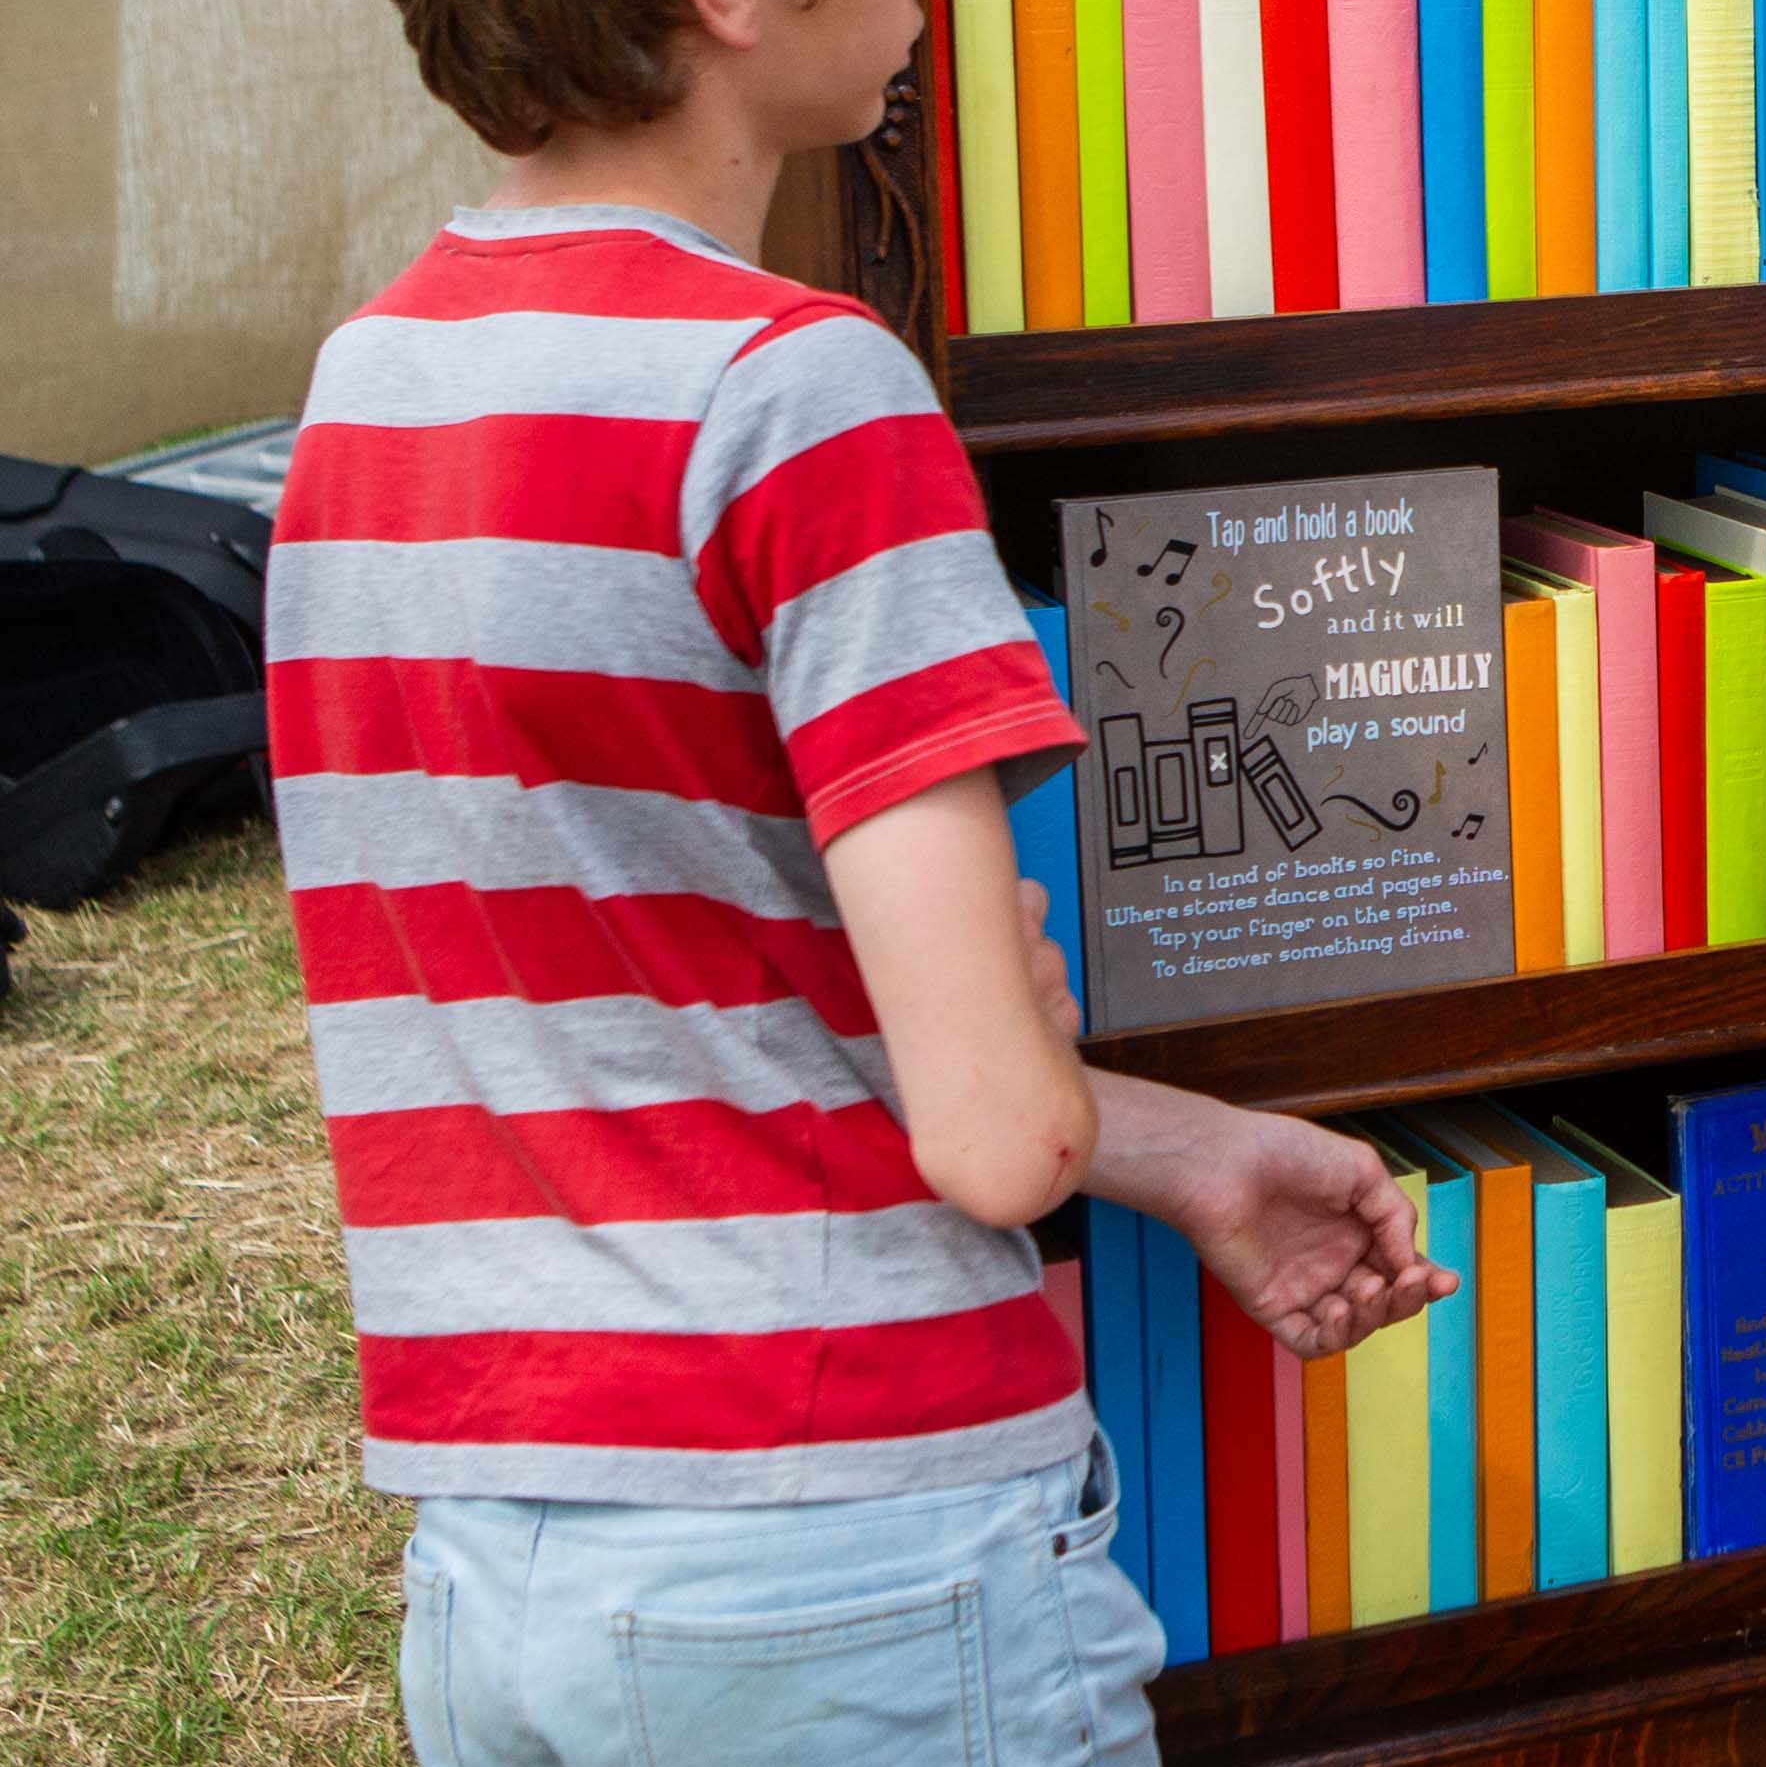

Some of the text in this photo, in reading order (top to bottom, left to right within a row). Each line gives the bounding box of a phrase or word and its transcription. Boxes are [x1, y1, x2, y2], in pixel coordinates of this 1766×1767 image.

[1205, 497, 1415, 556] Tap and hold a book
[1253, 546, 1406, 630] Softly
[1327, 603, 1465, 635] and it will
[1325, 651, 1492, 700] MAGICALLY
[1307, 708, 1466, 753] play a sound
[1163, 874, 1185, 893] In
[1187, 878, 1203, 892] a
[1207, 864, 1259, 890] land
[1265, 862, 1289, 882] of
[1294, 855, 1357, 878] books
[1362, 857, 1386, 870] so
[1105, 905, 1179, 927] Where
[1183, 893, 1258, 917] stories
[1263, 887, 1330, 907] dance
[1333, 877, 1375, 899] and
[1381, 874, 1443, 902] pages
[1148, 926, 1187, 951] Tap
[1191, 926, 1243, 950] your
[1249, 917, 1315, 940] finger
[1321, 914, 1349, 928] on
[1354, 905, 1391, 924] the
[1151, 959, 1177, 979] To
[1182, 952, 1273, 975] discover
[1279, 935, 1394, 962] something
